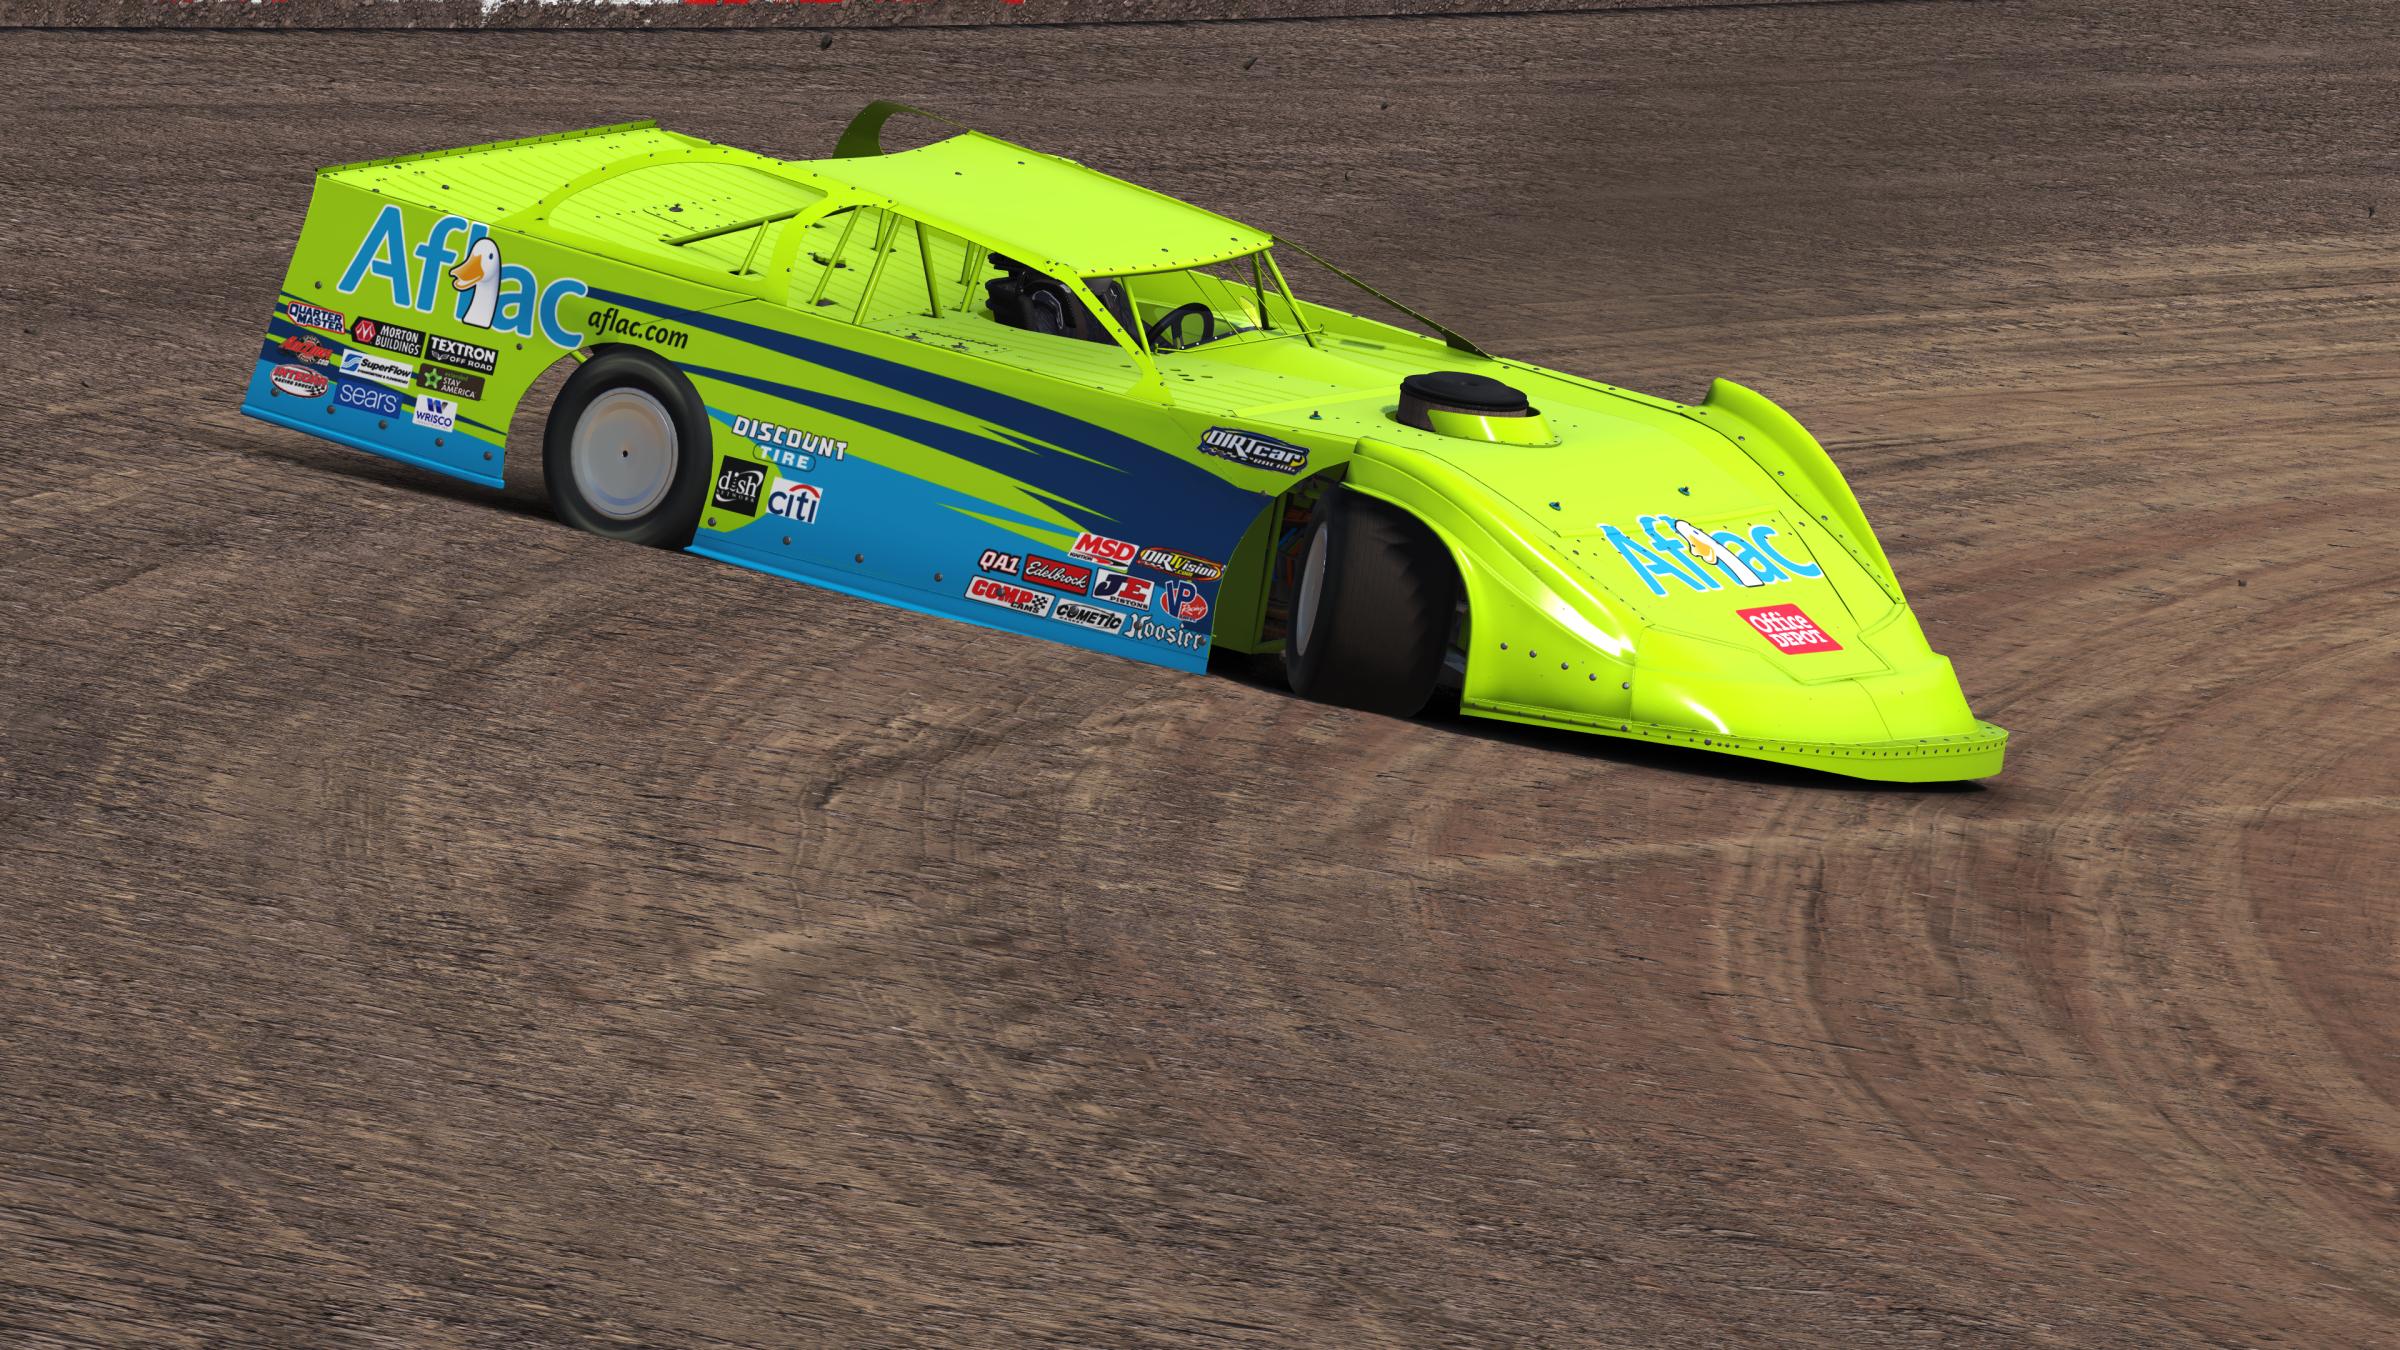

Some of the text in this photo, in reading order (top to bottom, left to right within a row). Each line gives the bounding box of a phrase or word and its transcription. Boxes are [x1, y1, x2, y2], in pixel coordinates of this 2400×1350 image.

[289, 303, 342, 321] QUARTER
[297, 314, 343, 333] MASTER
[380, 325, 419, 343] MORTON
[587, 308, 689, 350] aflac.com
[375, 335, 420, 356] BUILDINGS
[431, 336, 496, 364] TEXTRON
[360, 358, 411, 378] SuperFlow
[449, 356, 493, 372] OFF ROAD
[441, 384, 476, 399] AMERICA
[442, 377, 462, 388] STAY
[340, 384, 397, 413] sears
[416, 411, 453, 428] WRISCO
[732, 415, 848, 461] DISCOUNT
[1206, 429, 1301, 462] DIRTcar
[760, 445, 810, 470] TIRE
[718, 470, 757, 498] dish
[767, 491, 818, 523] citi
[1075, 533, 1137, 562] MSD
[979, 550, 1020, 575] QA1
[1025, 561, 1089, 588] Edelbrock
[971, 579, 1034, 605] COMP
[1094, 573, 1152, 603] JE
[1165, 580, 1198, 620] VP
[1010, 602, 1040, 614] CAMS
[1109, 595, 1149, 610] PISTONS
[1056, 604, 1122, 629] COMETIC
[1750, 611, 1813, 634] Office
[1124, 613, 1203, 650] Hoosier
[1769, 630, 1828, 648] DEPOT
